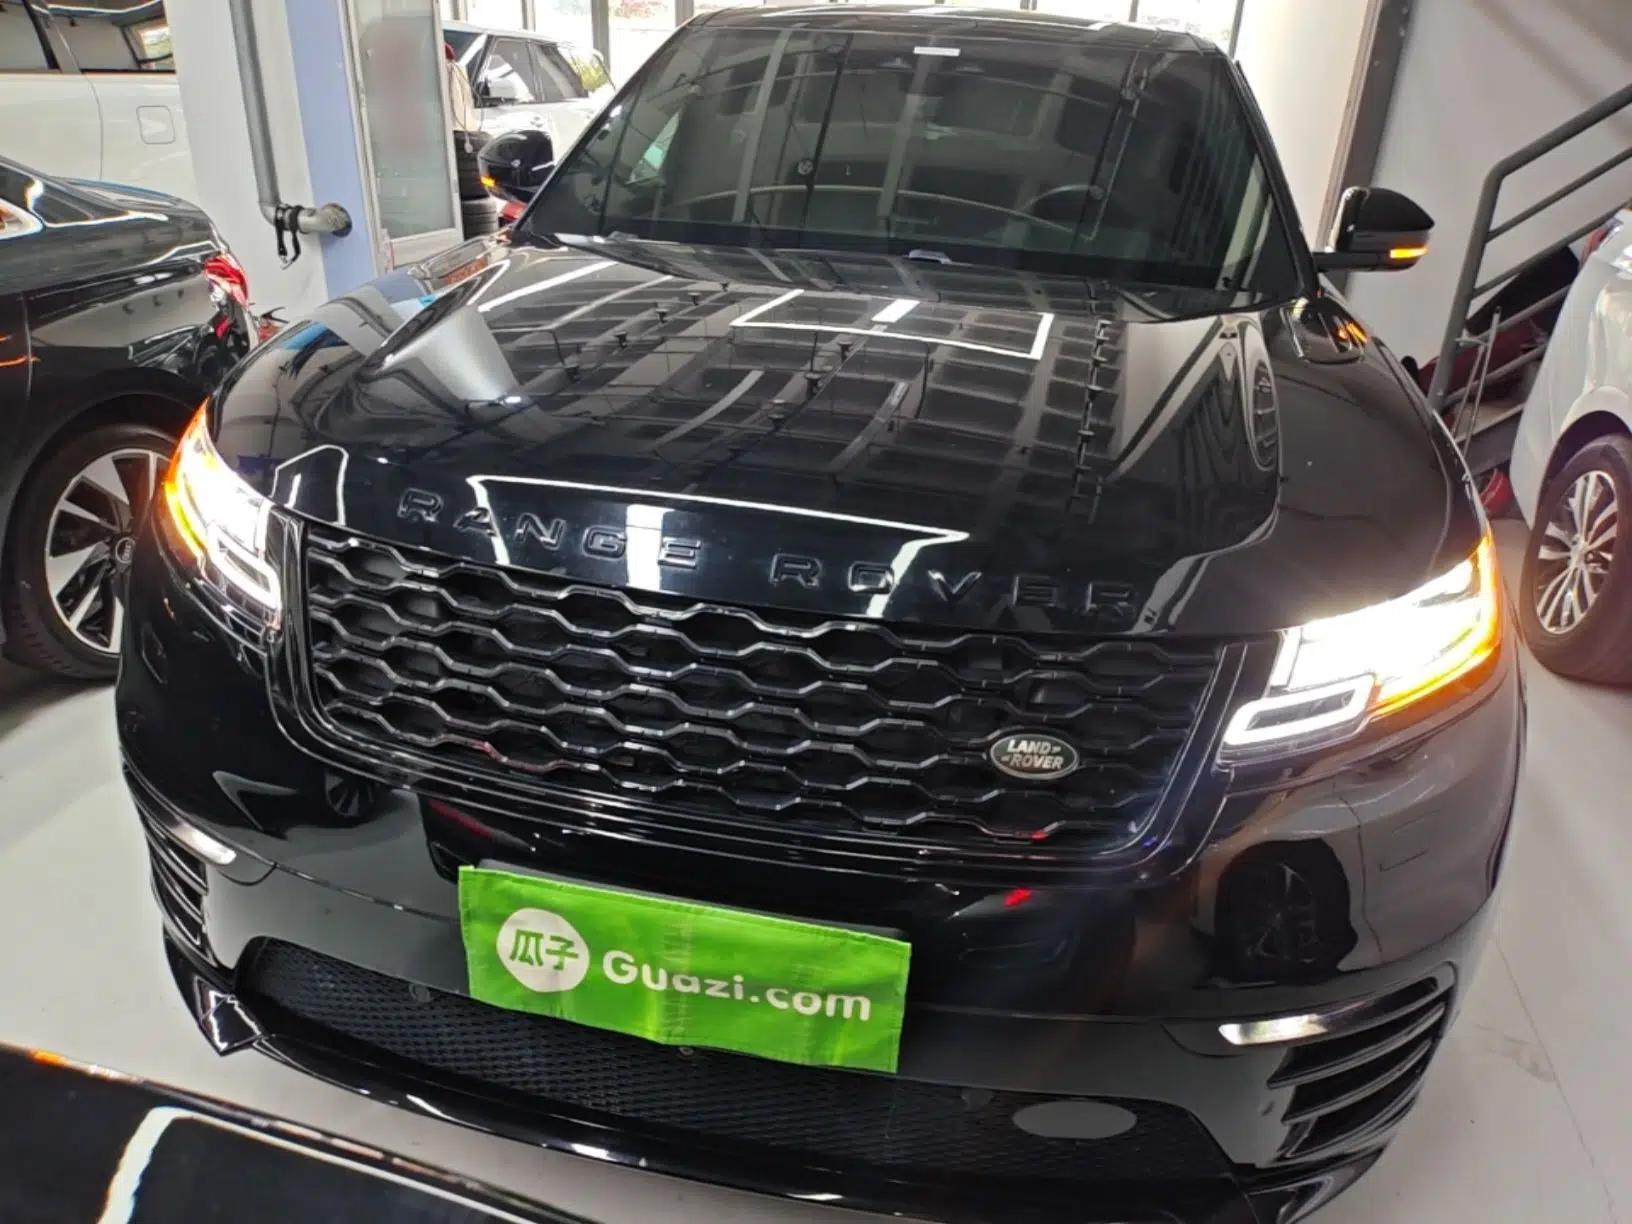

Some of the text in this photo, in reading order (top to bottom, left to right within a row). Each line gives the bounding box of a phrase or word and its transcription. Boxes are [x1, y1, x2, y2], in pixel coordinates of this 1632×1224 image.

[397, 488, 1138, 616] RANGE ROVER
[1007, 739, 1052, 755] LAND
[1009, 753, 1065, 769] ROVER
[509, 928, 580, 972] 瓜子
[602, 950, 871, 1021] Guazi.com
